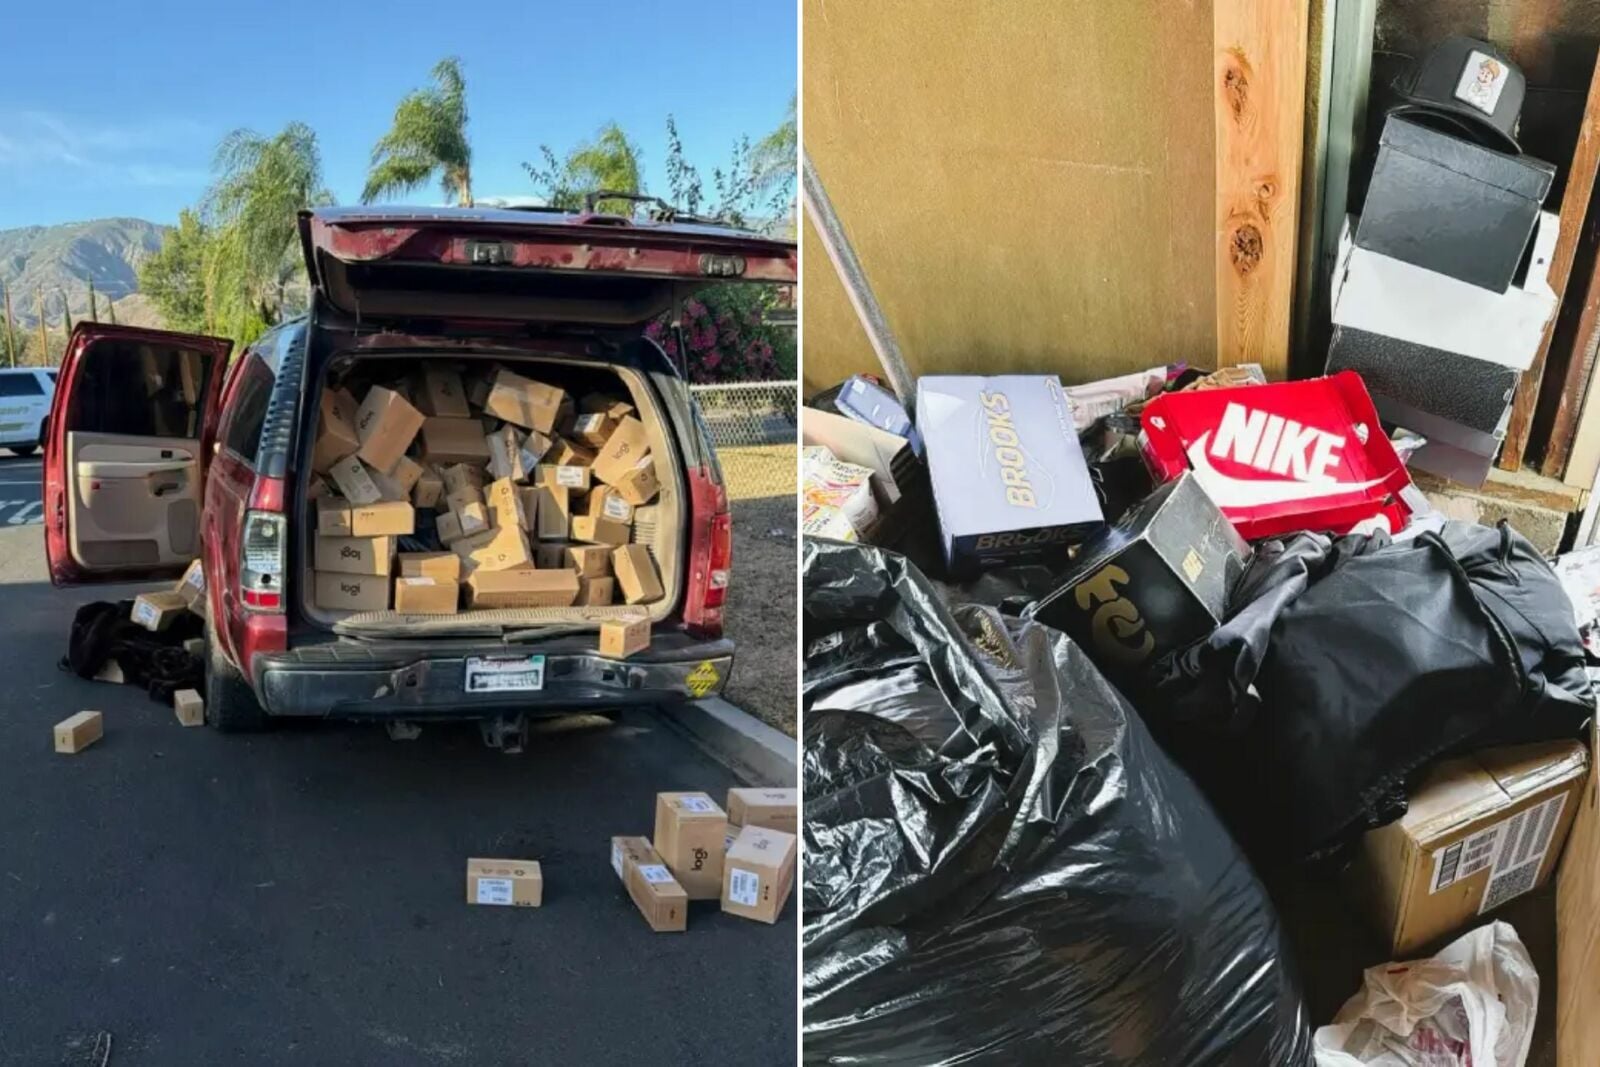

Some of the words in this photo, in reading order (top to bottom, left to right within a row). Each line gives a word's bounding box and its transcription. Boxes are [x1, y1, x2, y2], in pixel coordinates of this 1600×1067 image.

[978, 391, 1038, 509] BROOKS
[1210, 401, 1346, 483] NIKE
[340, 546, 361, 561] logi
[340, 582, 361, 597] logi
[691, 847, 709, 872] logi
